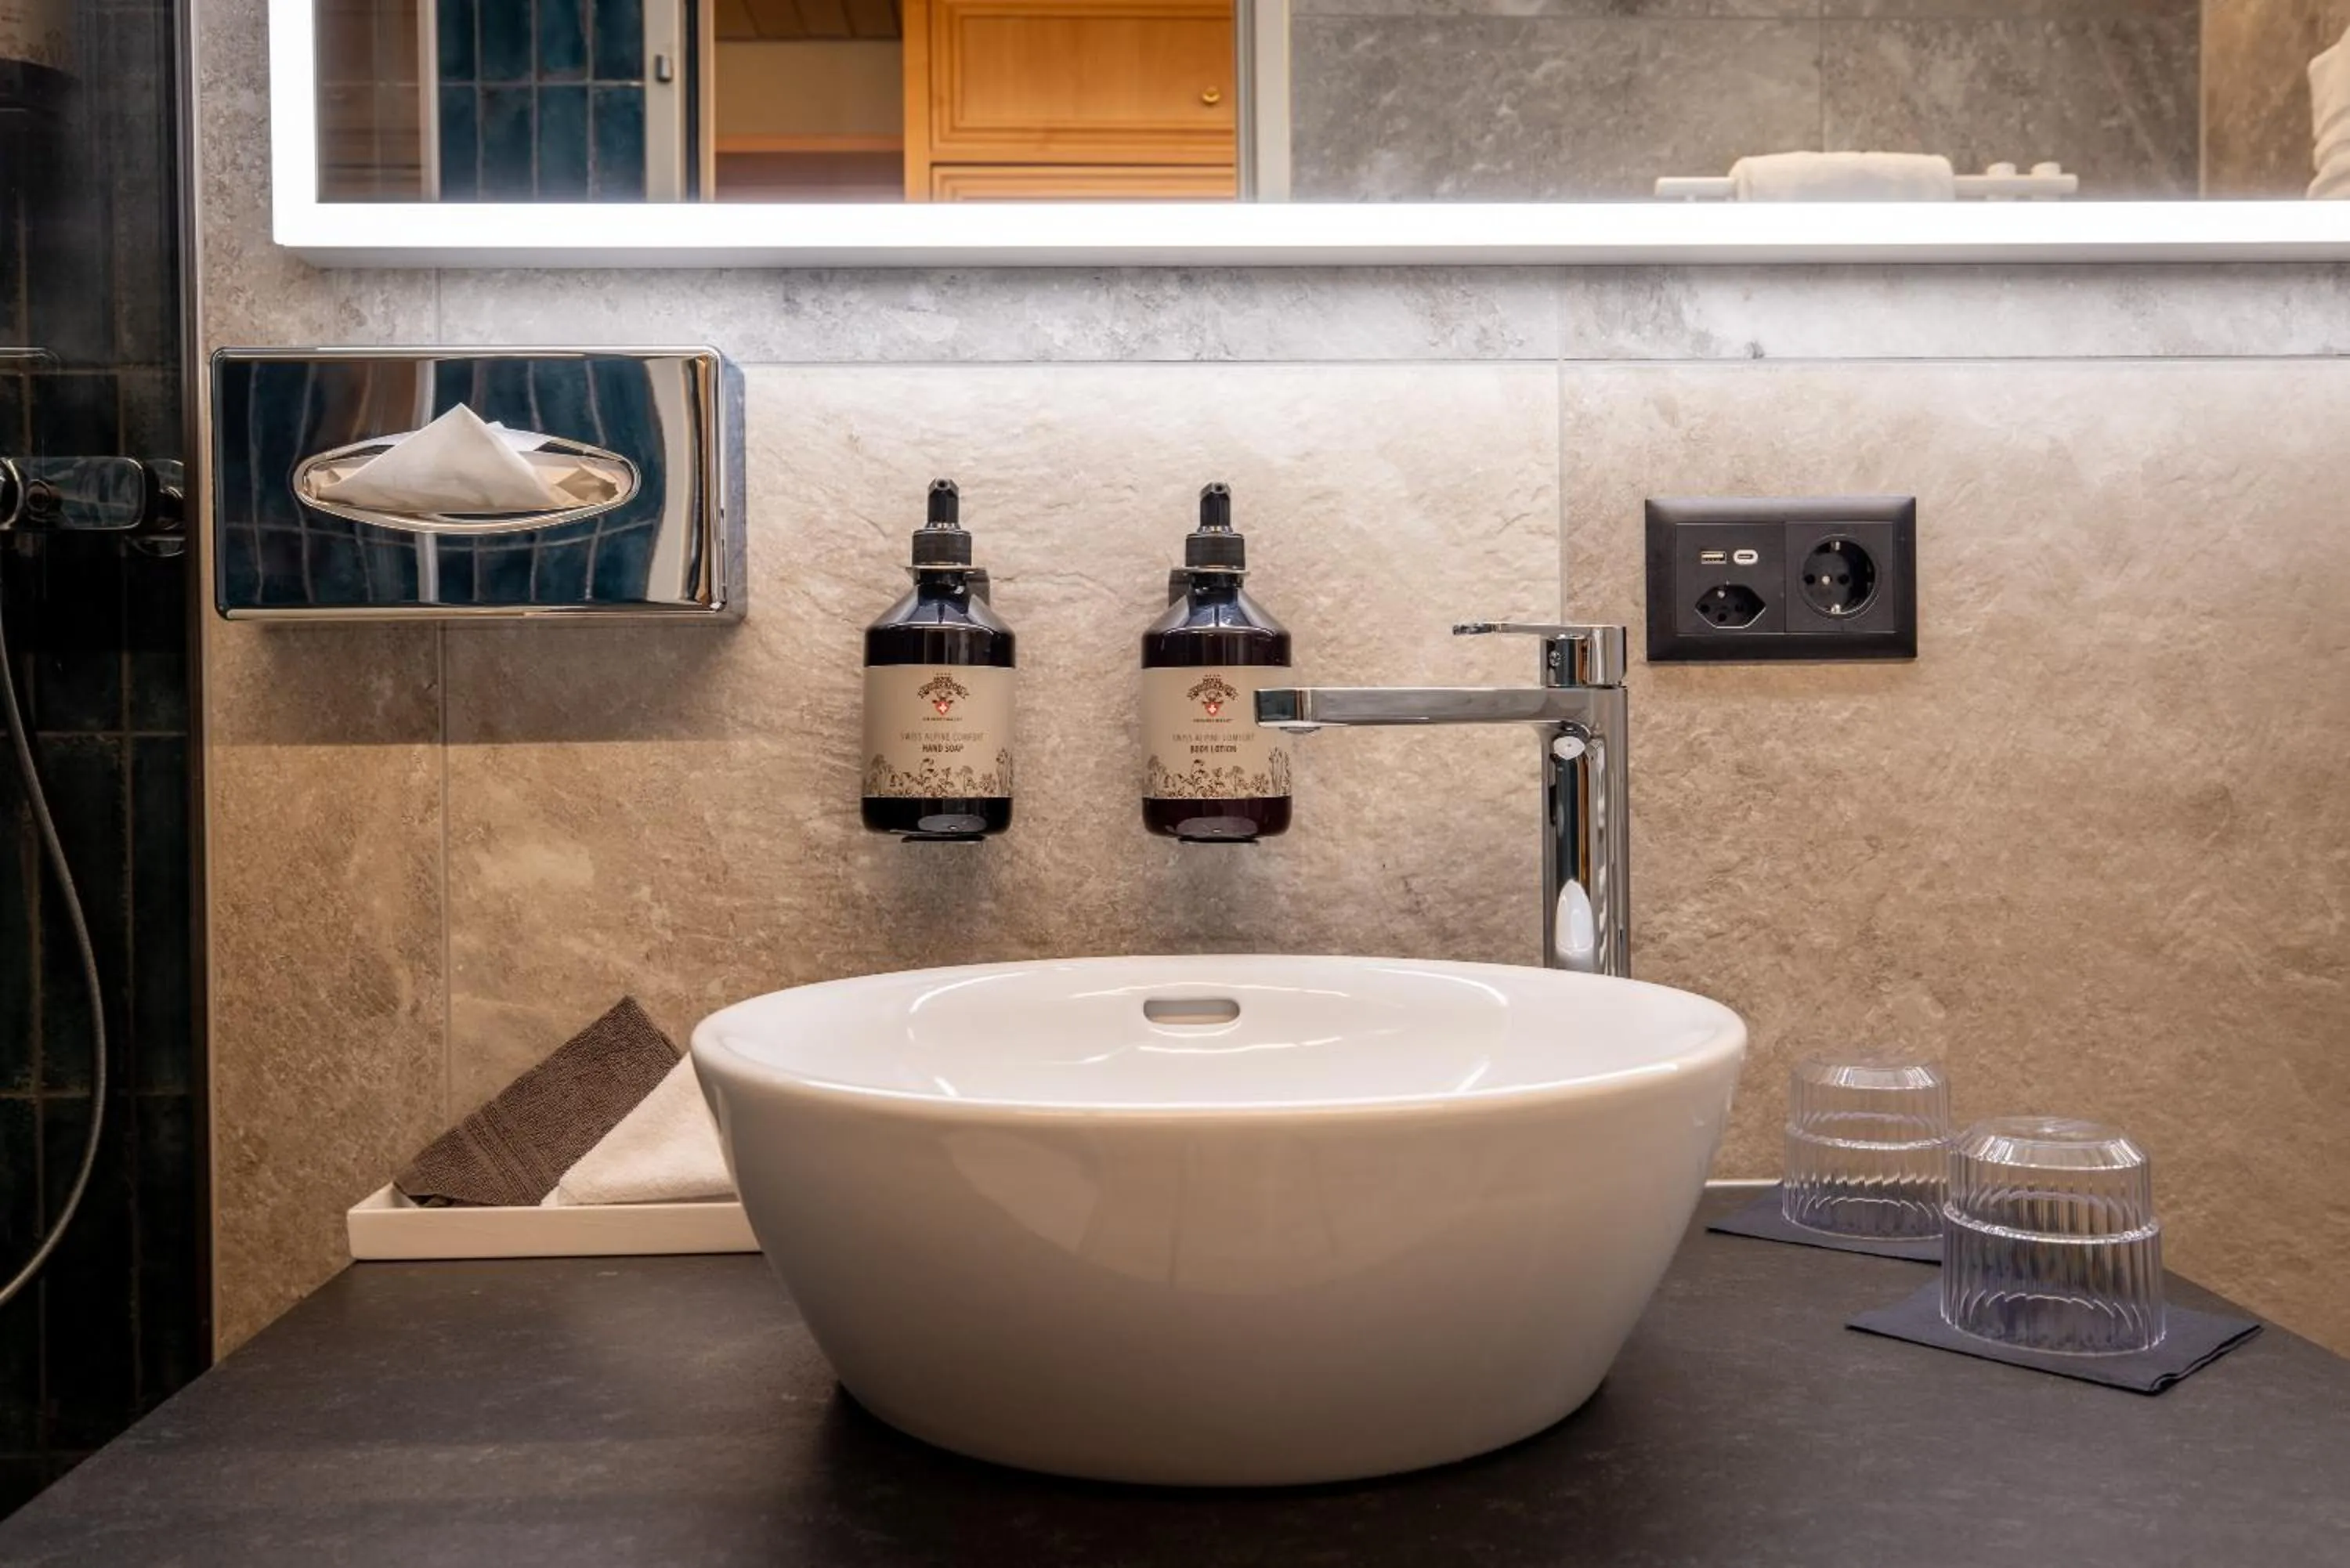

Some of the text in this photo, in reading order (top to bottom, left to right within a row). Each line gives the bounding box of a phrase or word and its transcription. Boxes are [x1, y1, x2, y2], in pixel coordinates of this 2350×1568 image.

[922, 744, 964, 753] HAND SOAP
[1210, 745, 1237, 753] LOTION
